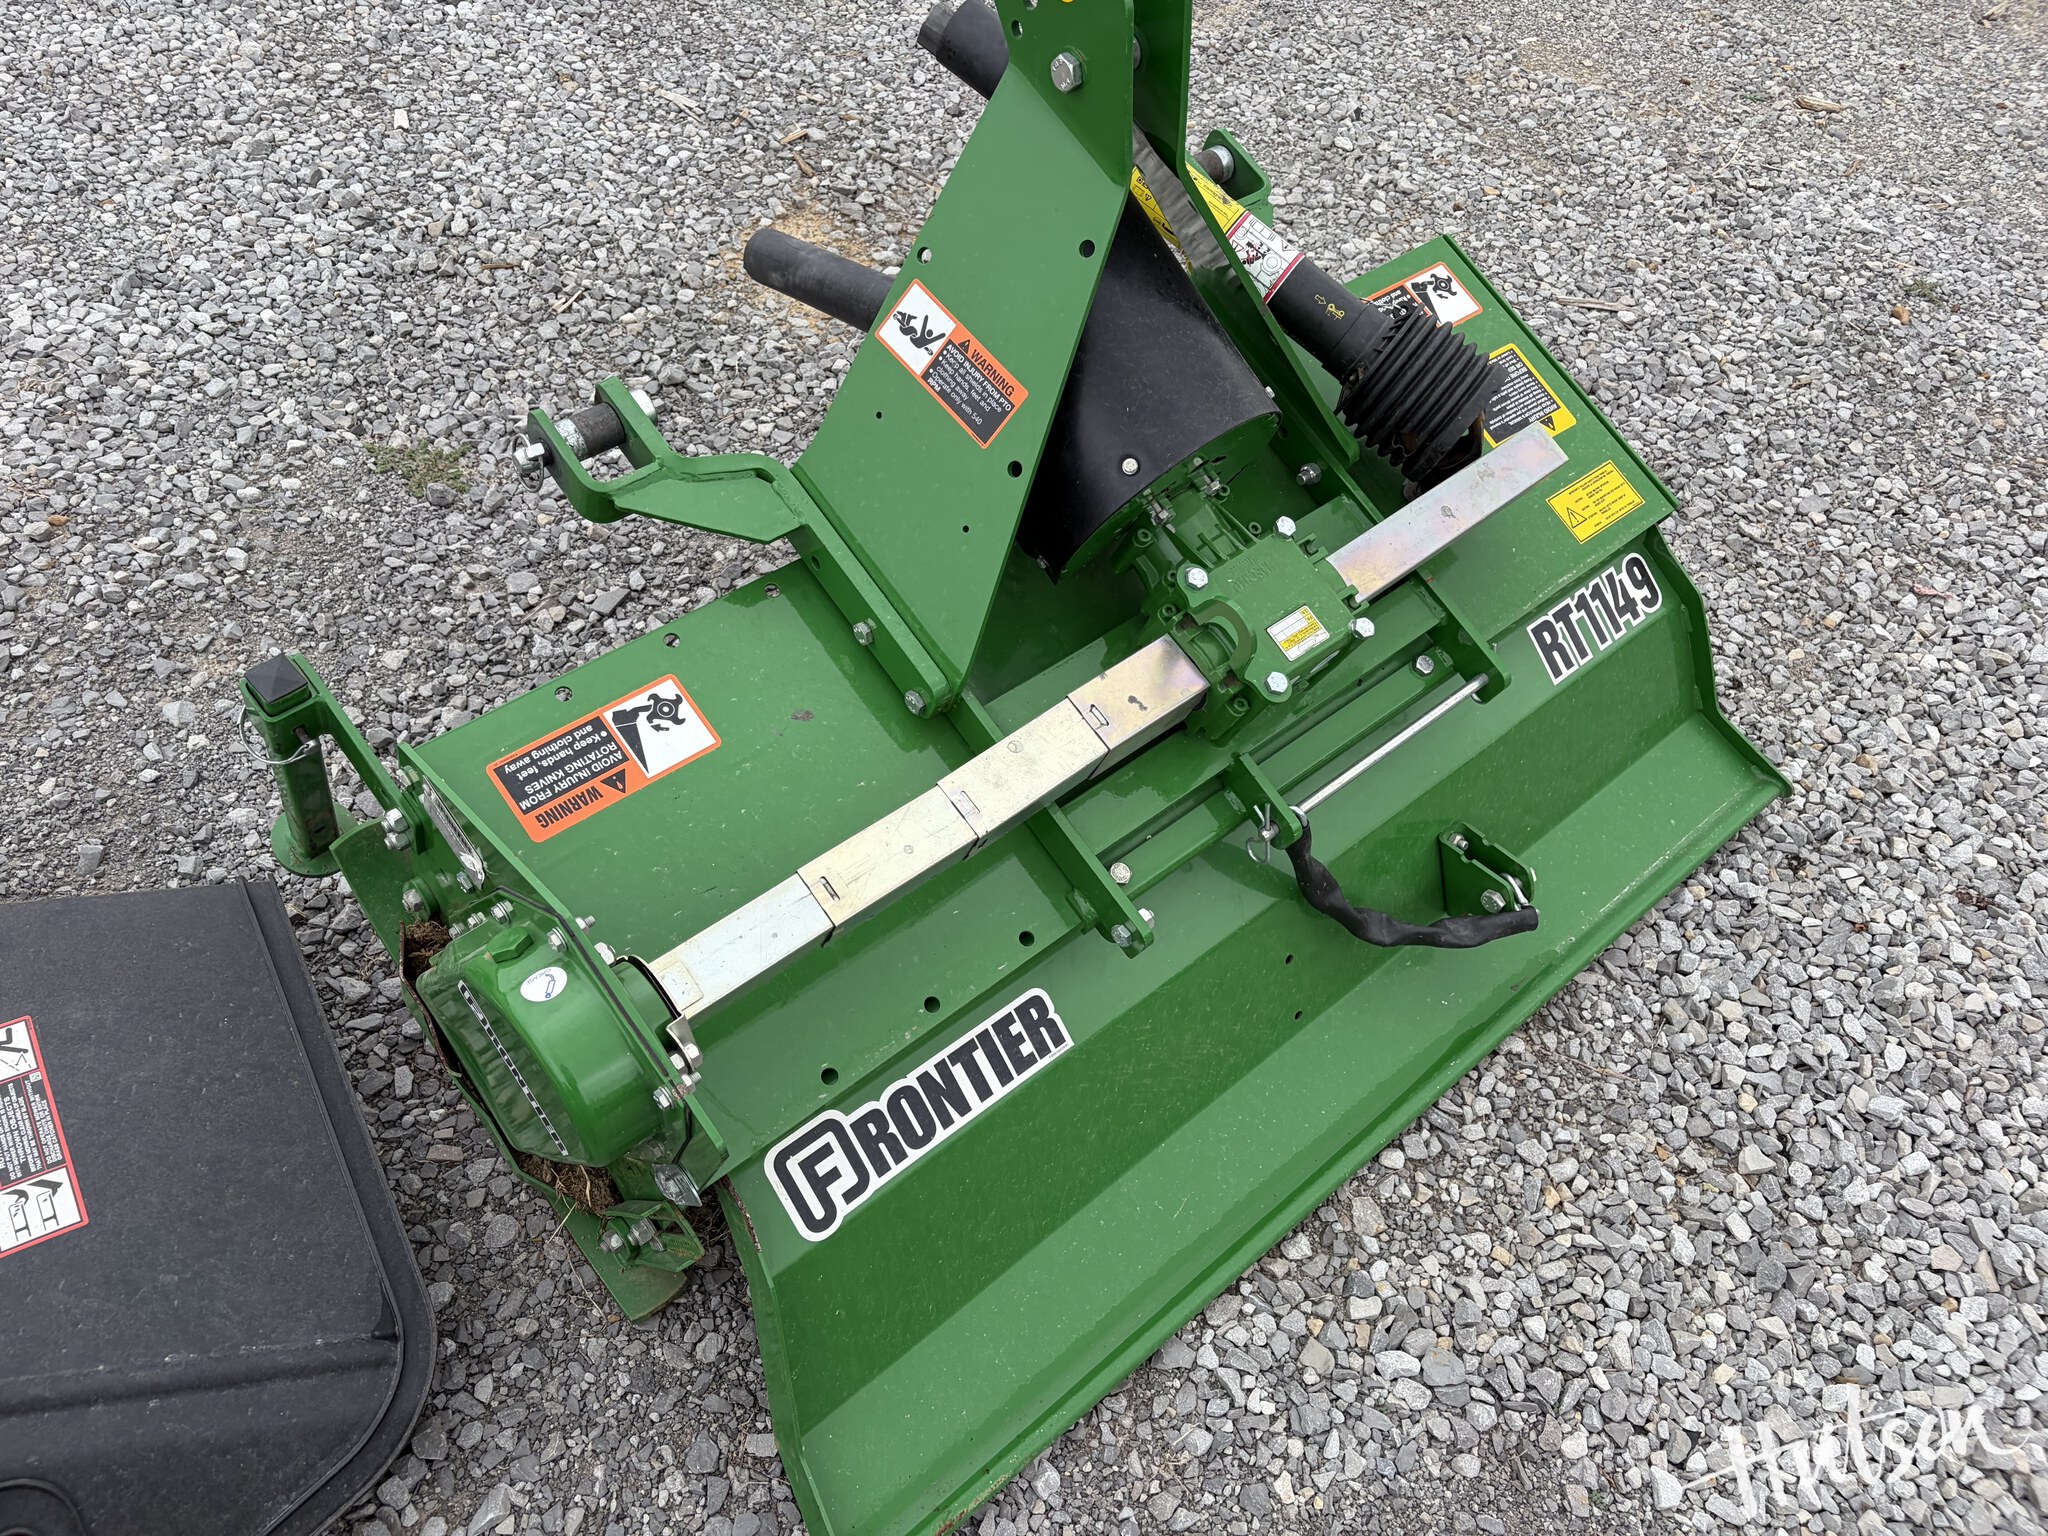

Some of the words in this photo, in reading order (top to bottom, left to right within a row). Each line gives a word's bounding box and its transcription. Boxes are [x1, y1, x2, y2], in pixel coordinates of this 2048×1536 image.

[928, 378, 941, 392] RPM
[937, 366, 956, 388] clothing
[955, 386, 969, 400] away
[941, 359, 954, 374] Keep
[954, 372, 969, 392] hands,
[971, 389, 981, 401] feet
[980, 400, 991, 411] and
[946, 353, 959, 369] Keep
[965, 374, 983, 393] shields
[987, 397, 1001, 412] place
[947, 345, 964, 362] AVOID
[963, 361, 984, 382] INJURY
[983, 381, 1000, 399] FROM
[999, 397, 1011, 411] PTO
[971, 350, 1014, 397] WARNING
[932, 372, 951, 393] Operate
[951, 392, 962, 404] only
[961, 403, 972, 415] with
[971, 413, 982, 425] 540
[1544, 404, 1557, 413] AVOID
[1529, 411, 1544, 422] INJURY
[1530, 557, 1659, 679] RT1149
[574, 725, 593, 739] and
[574, 734, 601, 750] Keep
[531, 736, 572, 759] clothing
[538, 748, 573, 766] hands,
[565, 742, 617, 773] ROTATING
[505, 757, 530, 773] away
[517, 766, 538, 780] feet
[592, 751, 622, 771] AVOID
[525, 770, 564, 794] KNIVES
[554, 768, 591, 793] INJURY
[520, 788, 552, 809] FROM
[535, 786, 604, 828] WARNING
[526, 969, 551, 985] GREASE
[4, 1097, 17, 1129] OBJECTS
[773, 995, 1066, 1233] FRONTIER
[13, 1131, 26, 1163] THROWN
